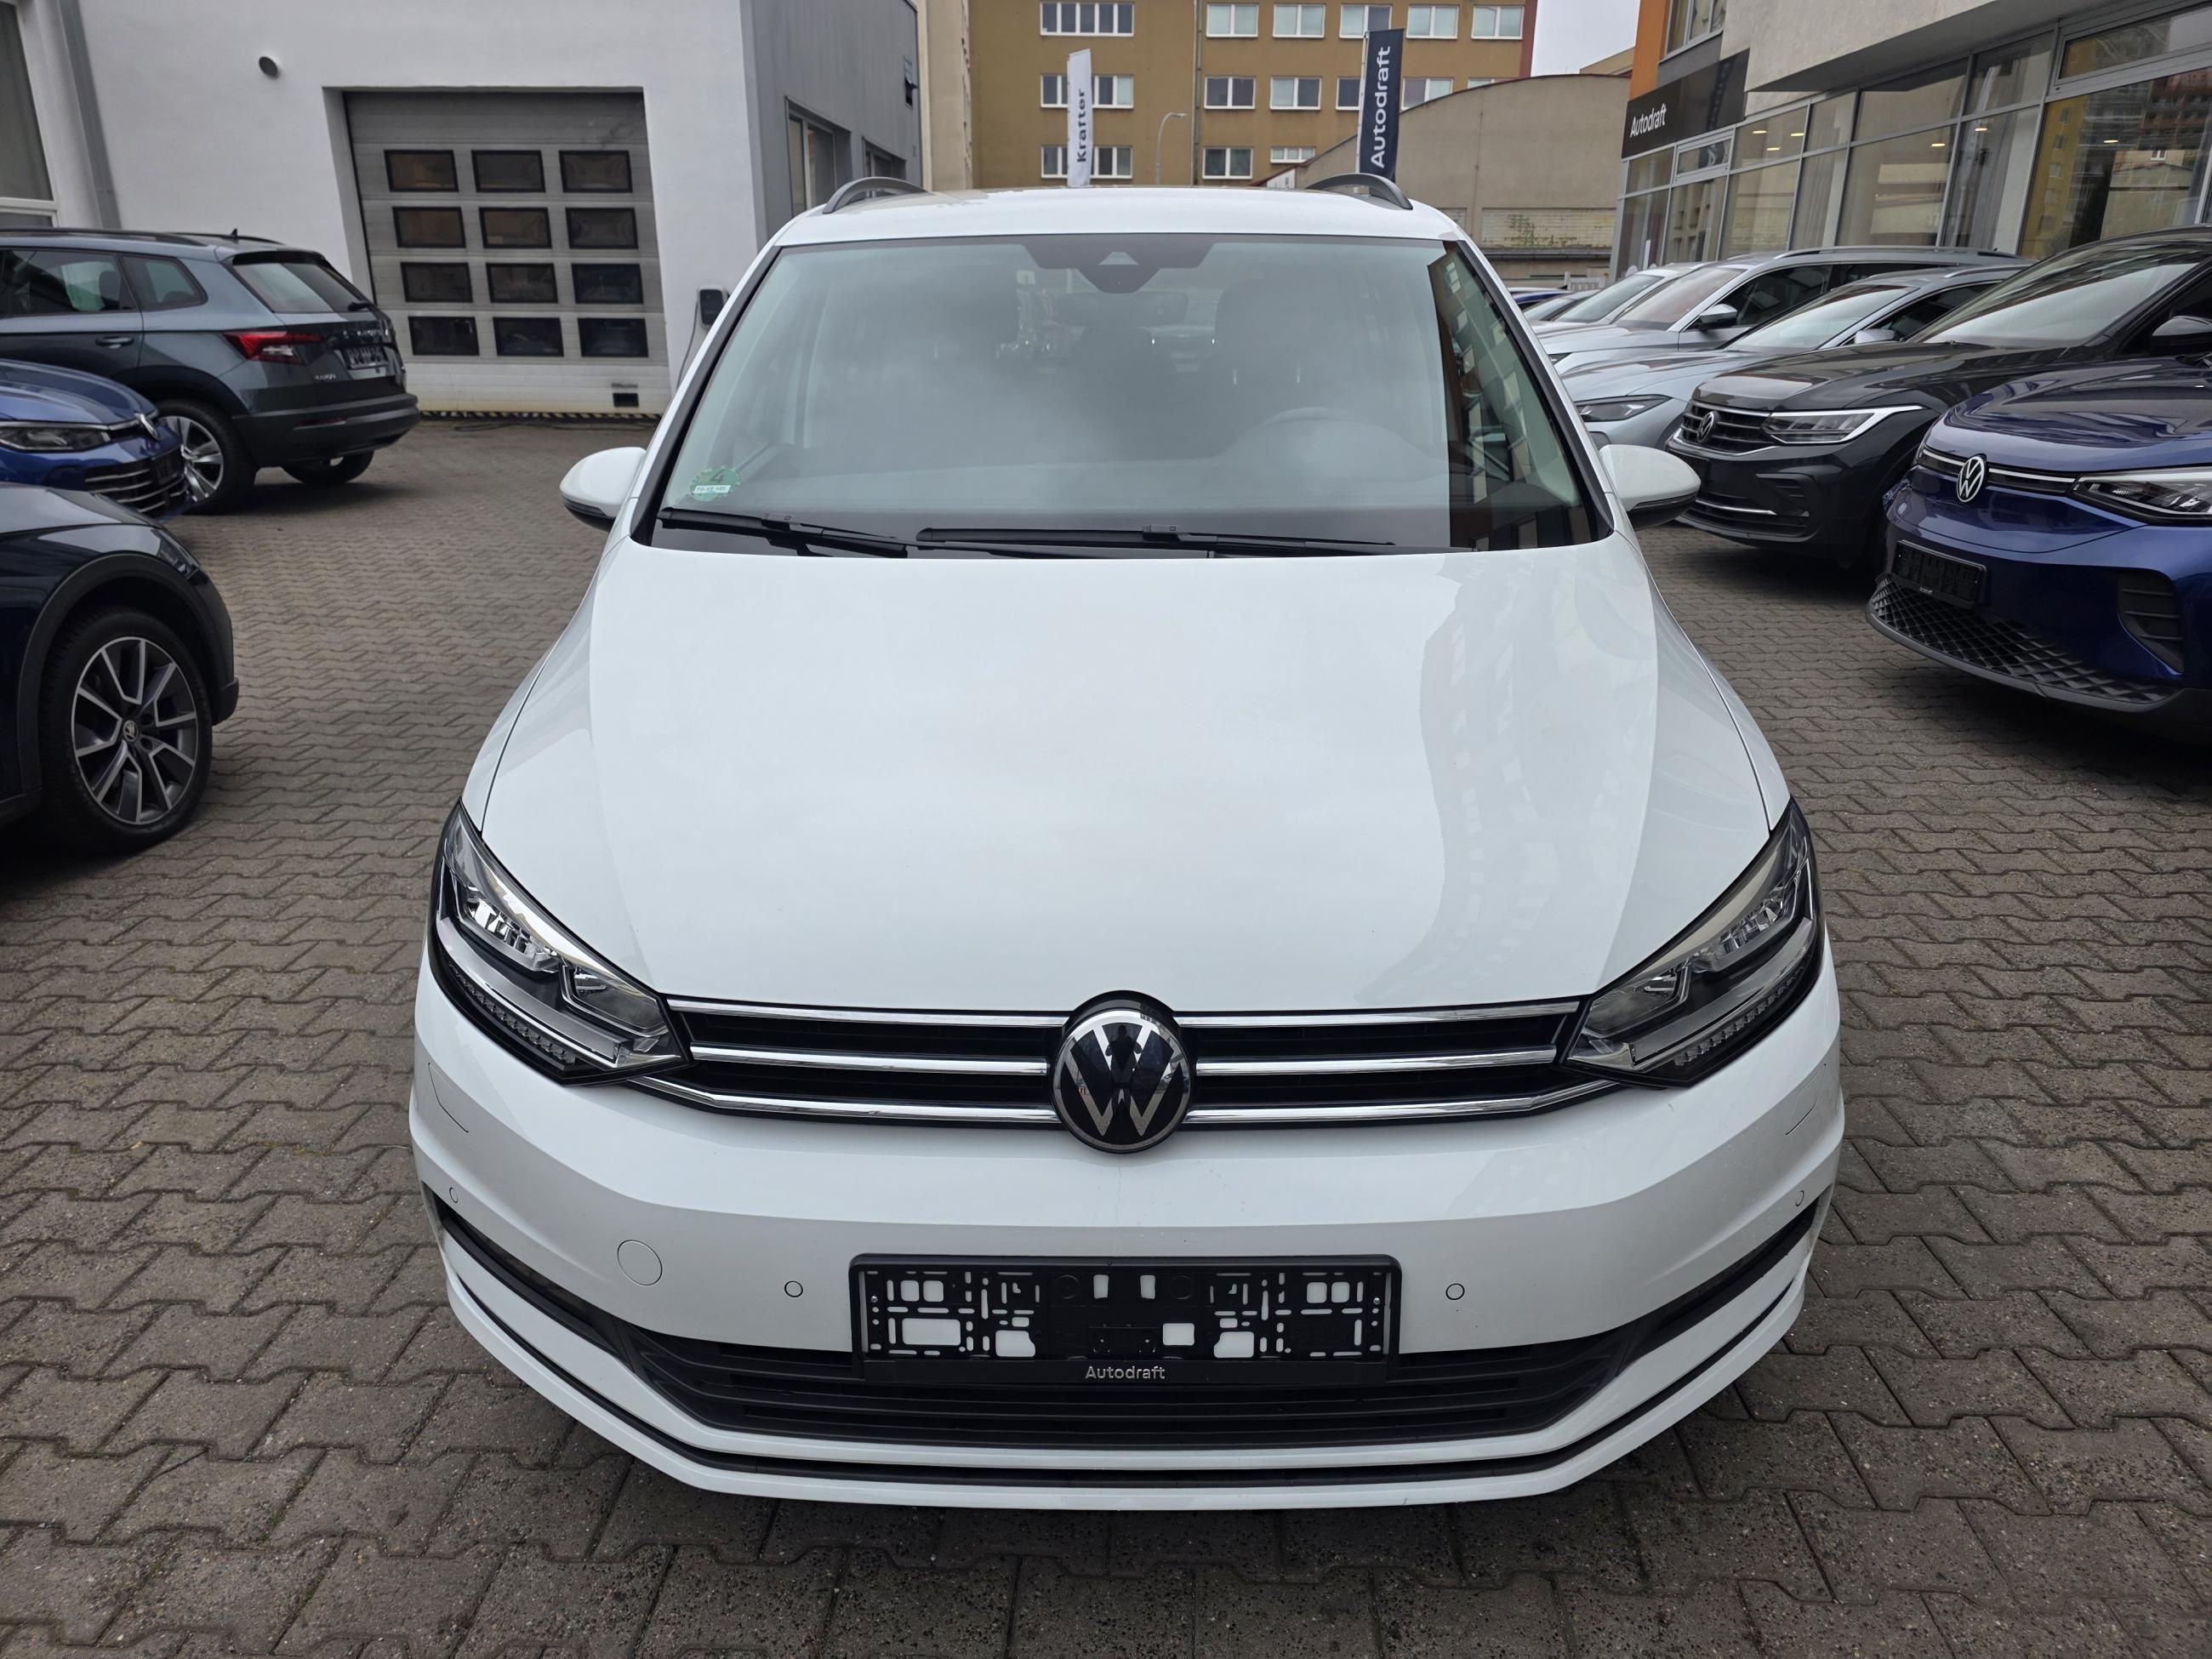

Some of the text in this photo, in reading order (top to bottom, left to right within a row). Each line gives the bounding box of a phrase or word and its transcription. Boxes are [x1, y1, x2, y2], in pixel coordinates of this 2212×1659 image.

[1076, 88, 1086, 162] Krafter
[1371, 46, 1391, 168] Autodraft
[1630, 103, 1667, 138] Autodraft
[1086, 1365, 1166, 1379] Autodraft
